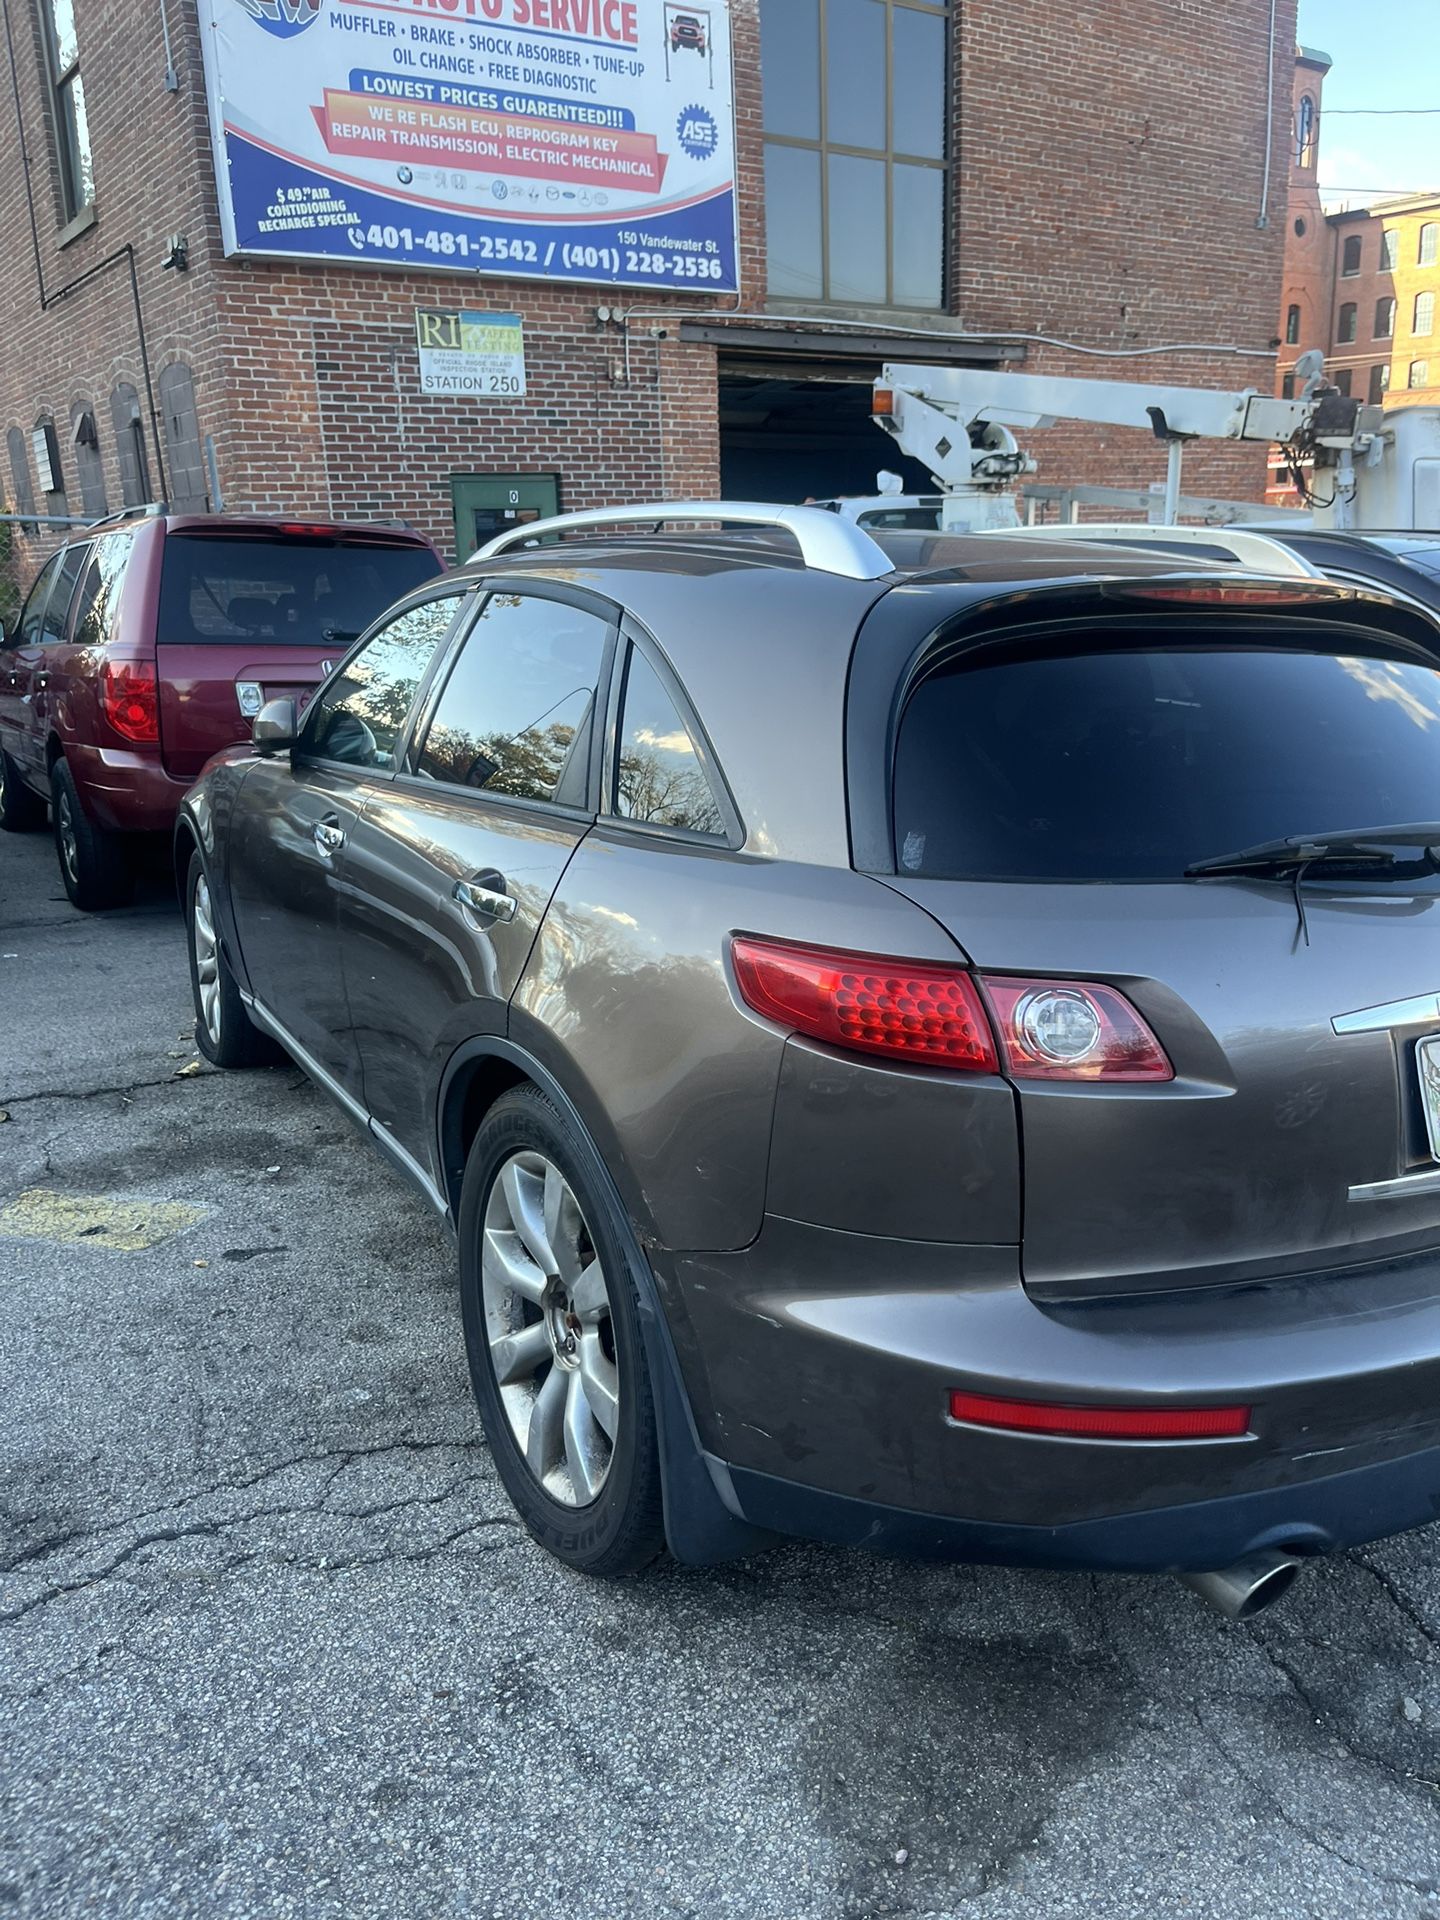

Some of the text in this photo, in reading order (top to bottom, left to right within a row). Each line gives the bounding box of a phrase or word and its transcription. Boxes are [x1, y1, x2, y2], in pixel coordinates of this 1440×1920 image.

[513, 0, 638, 43] SERVICE
[330, 12, 396, 37] MUFFLER
[411, 25, 455, 46] BRAKE
[469, 34, 512, 56] SHOCK
[517, 44, 581, 67] ABSORBER
[593, 55, 645, 78] TUNE-UP
[393, 48, 597, 94] OIL CHANGE FREE DIAGNOSTIC
[363, 75, 623, 128] LOWEST PRICES GUARENTEED!!!
[331, 122, 655, 177] REPAIR TRANSMISSION, ELECTRIC MECHANICAL
[368, 105, 618, 153] WE RE FLASH ECU, REPROGRAM KEY
[682, 119, 712, 141] ASE
[311, 187, 331, 200] AIR
[258, 212, 361, 232] RECHARGE SPECIAL
[617, 231, 720, 254] 150 Vandewater St.
[367, 225, 537, 262] 401-481-2542
[562, 243, 620, 273] (401)
[626, 251, 722, 280] 228-2536
[419, 313, 460, 347] RI
[425, 376, 520, 392] STATION 250
